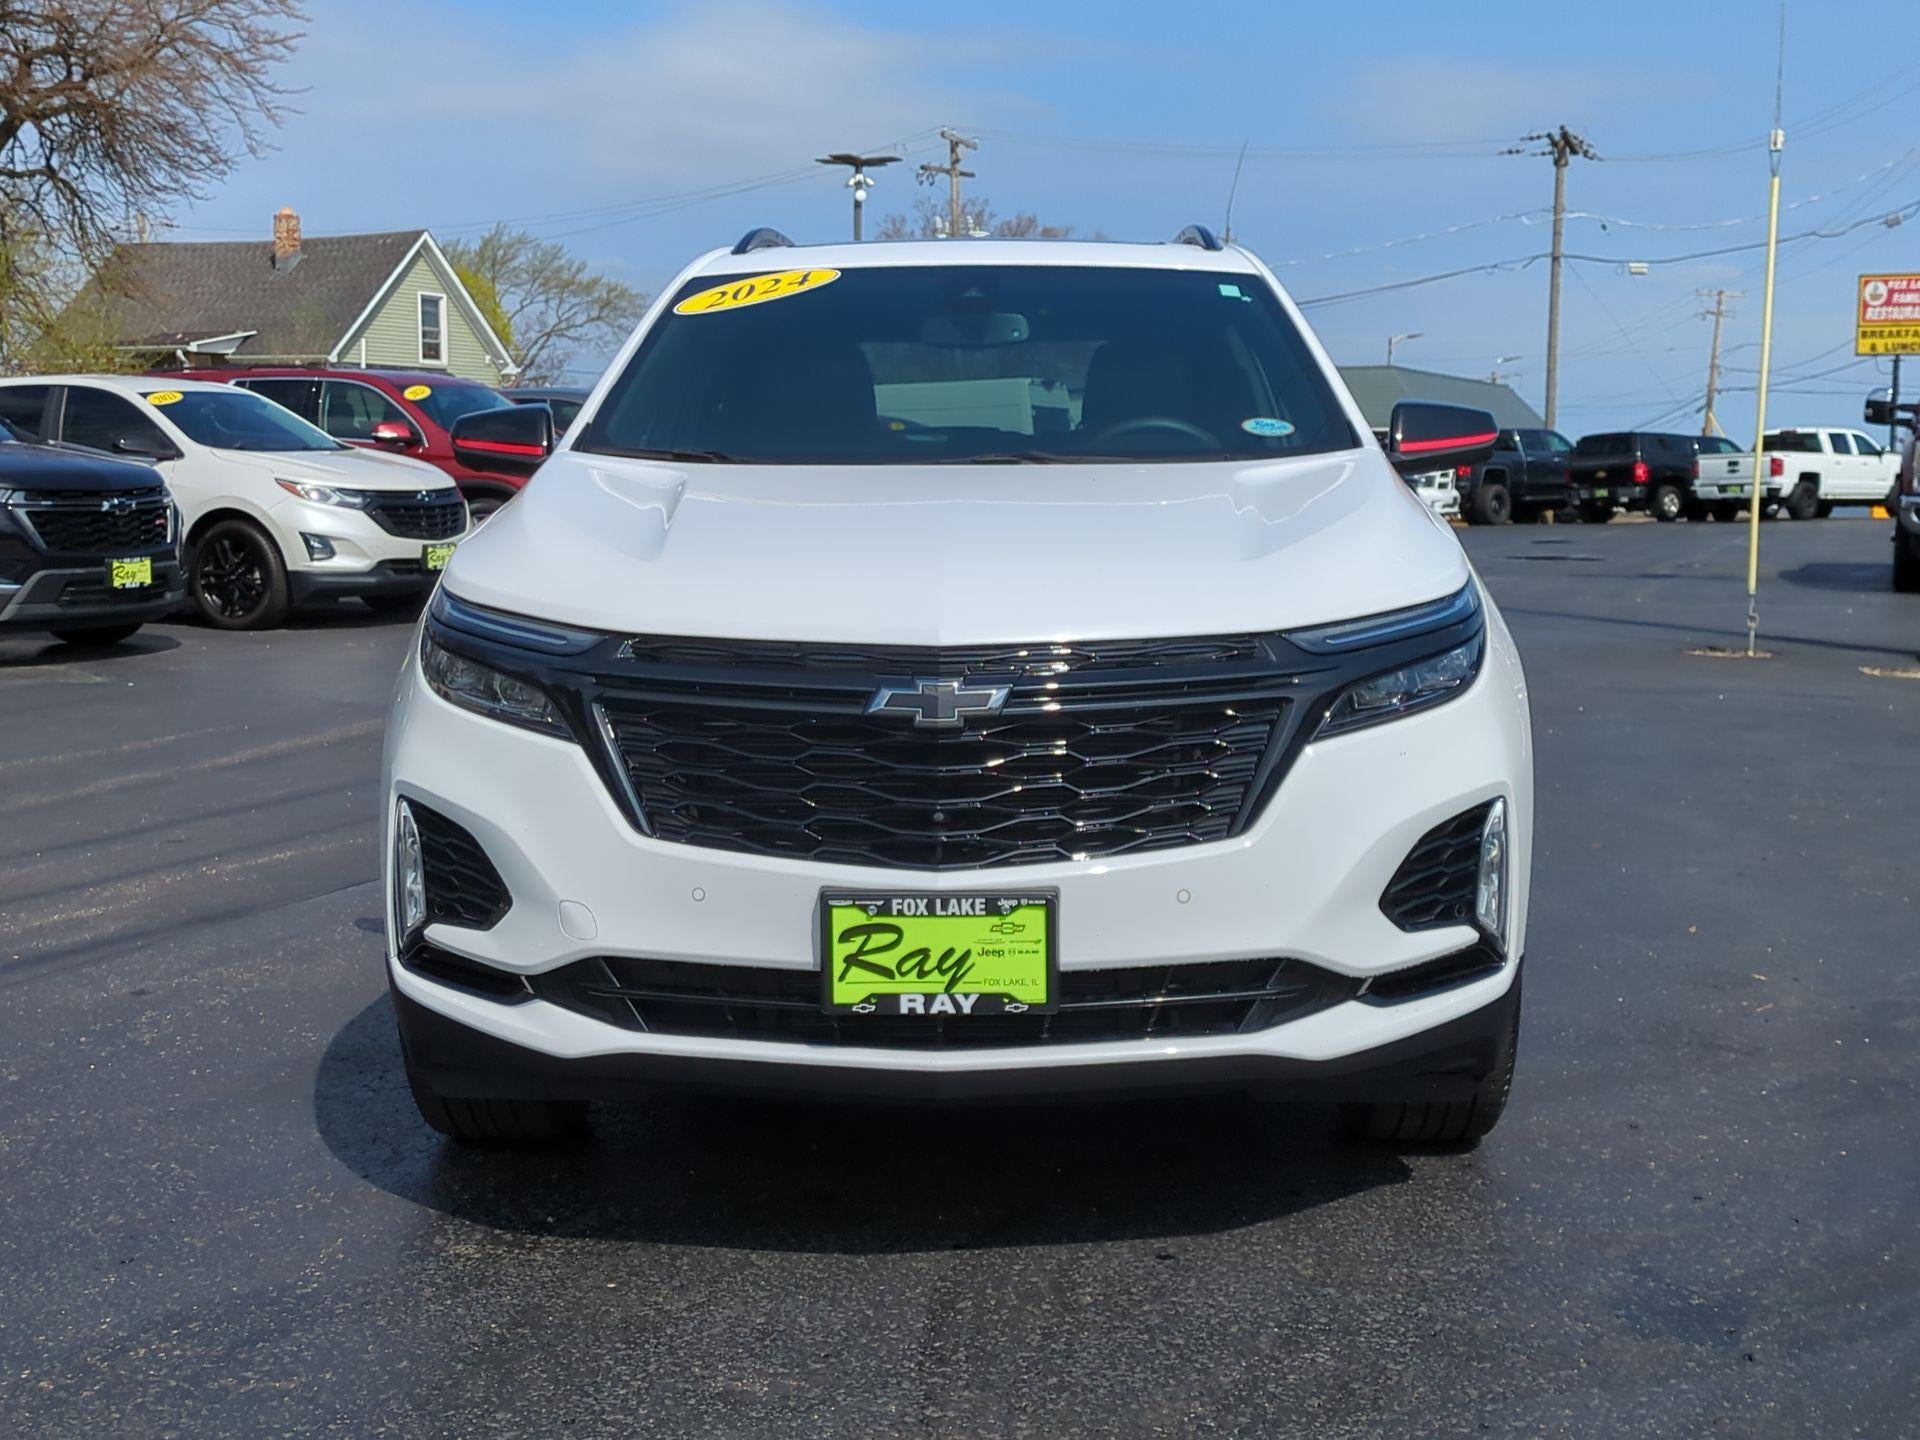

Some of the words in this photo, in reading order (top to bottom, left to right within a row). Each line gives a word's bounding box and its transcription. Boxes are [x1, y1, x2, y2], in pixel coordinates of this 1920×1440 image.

[704, 271, 812, 309] 2024
[113, 565, 137, 582] Ray
[892, 898, 929, 916] FOX
[936, 898, 986, 916] LAKE
[998, 898, 1018, 907] Jeep
[838, 922, 976, 993] Ray
[977, 947, 1005, 958] Jeep
[983, 978, 1001, 986] FOX
[1031, 978, 1040, 986] IL
[900, 994, 980, 1015] RAY
